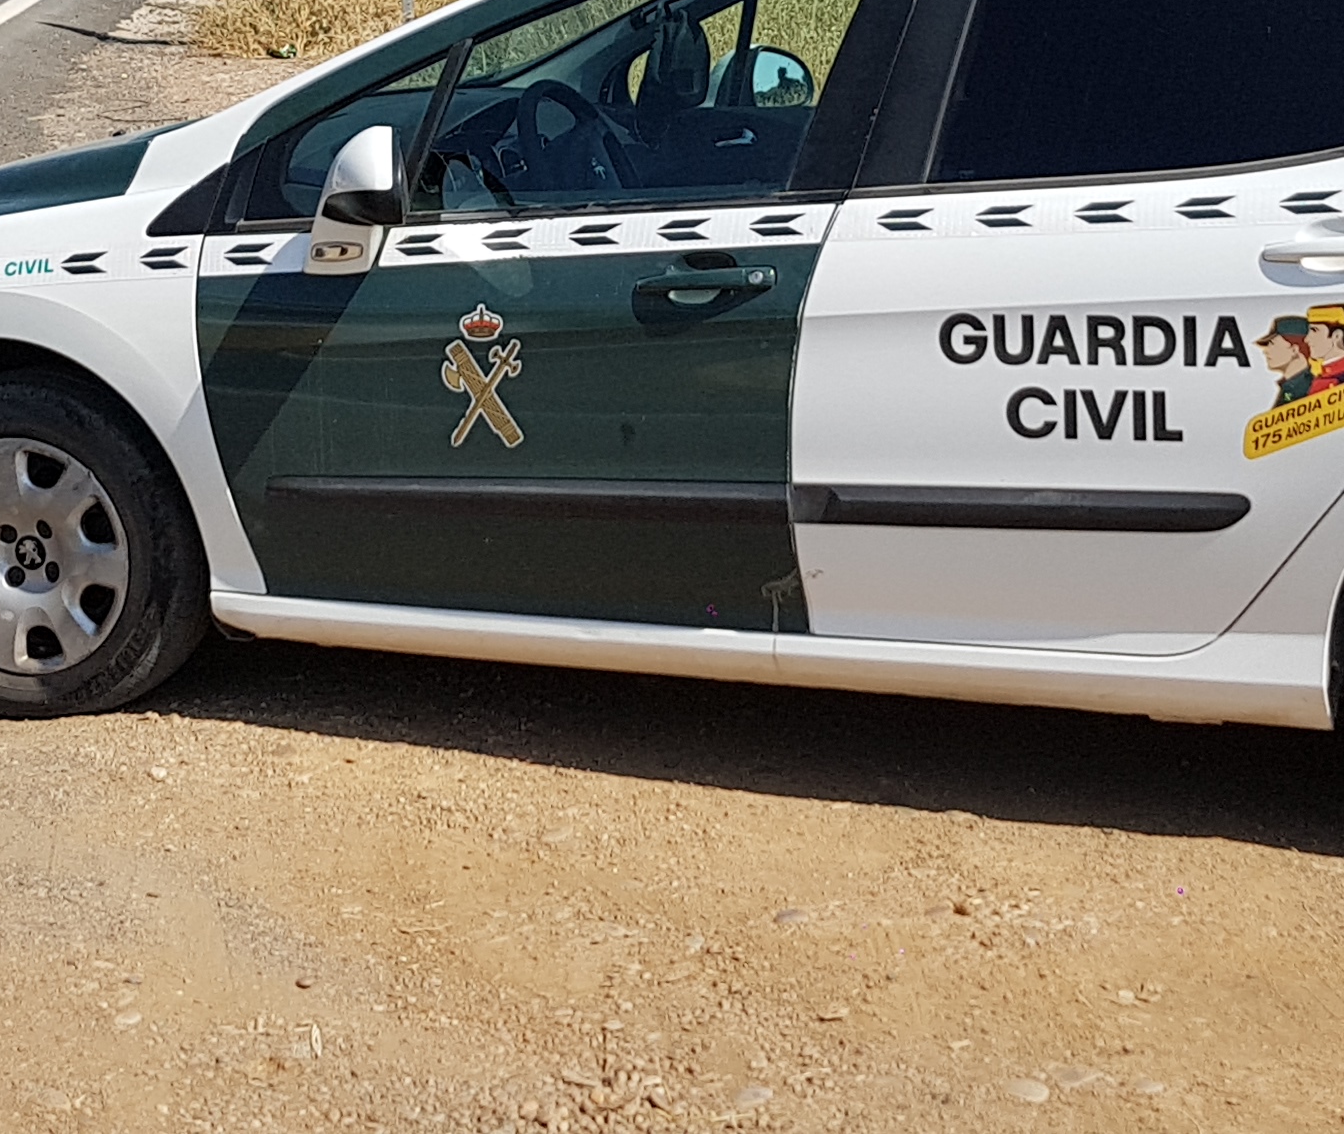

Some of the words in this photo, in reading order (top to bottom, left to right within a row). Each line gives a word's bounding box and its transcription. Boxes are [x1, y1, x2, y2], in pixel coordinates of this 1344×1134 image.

[4, 258, 54, 277] CIVIL
[938, 312, 1252, 368] GUARDIA
[1006, 386, 1184, 442] CIVIL
[1251, 428, 1283, 451] 175
[1285, 419, 1312, 441] AÑOS
[1313, 416, 1320, 429] A
[1323, 410, 1336, 426] TU
[1252, 398, 1323, 433] GUARDIA
